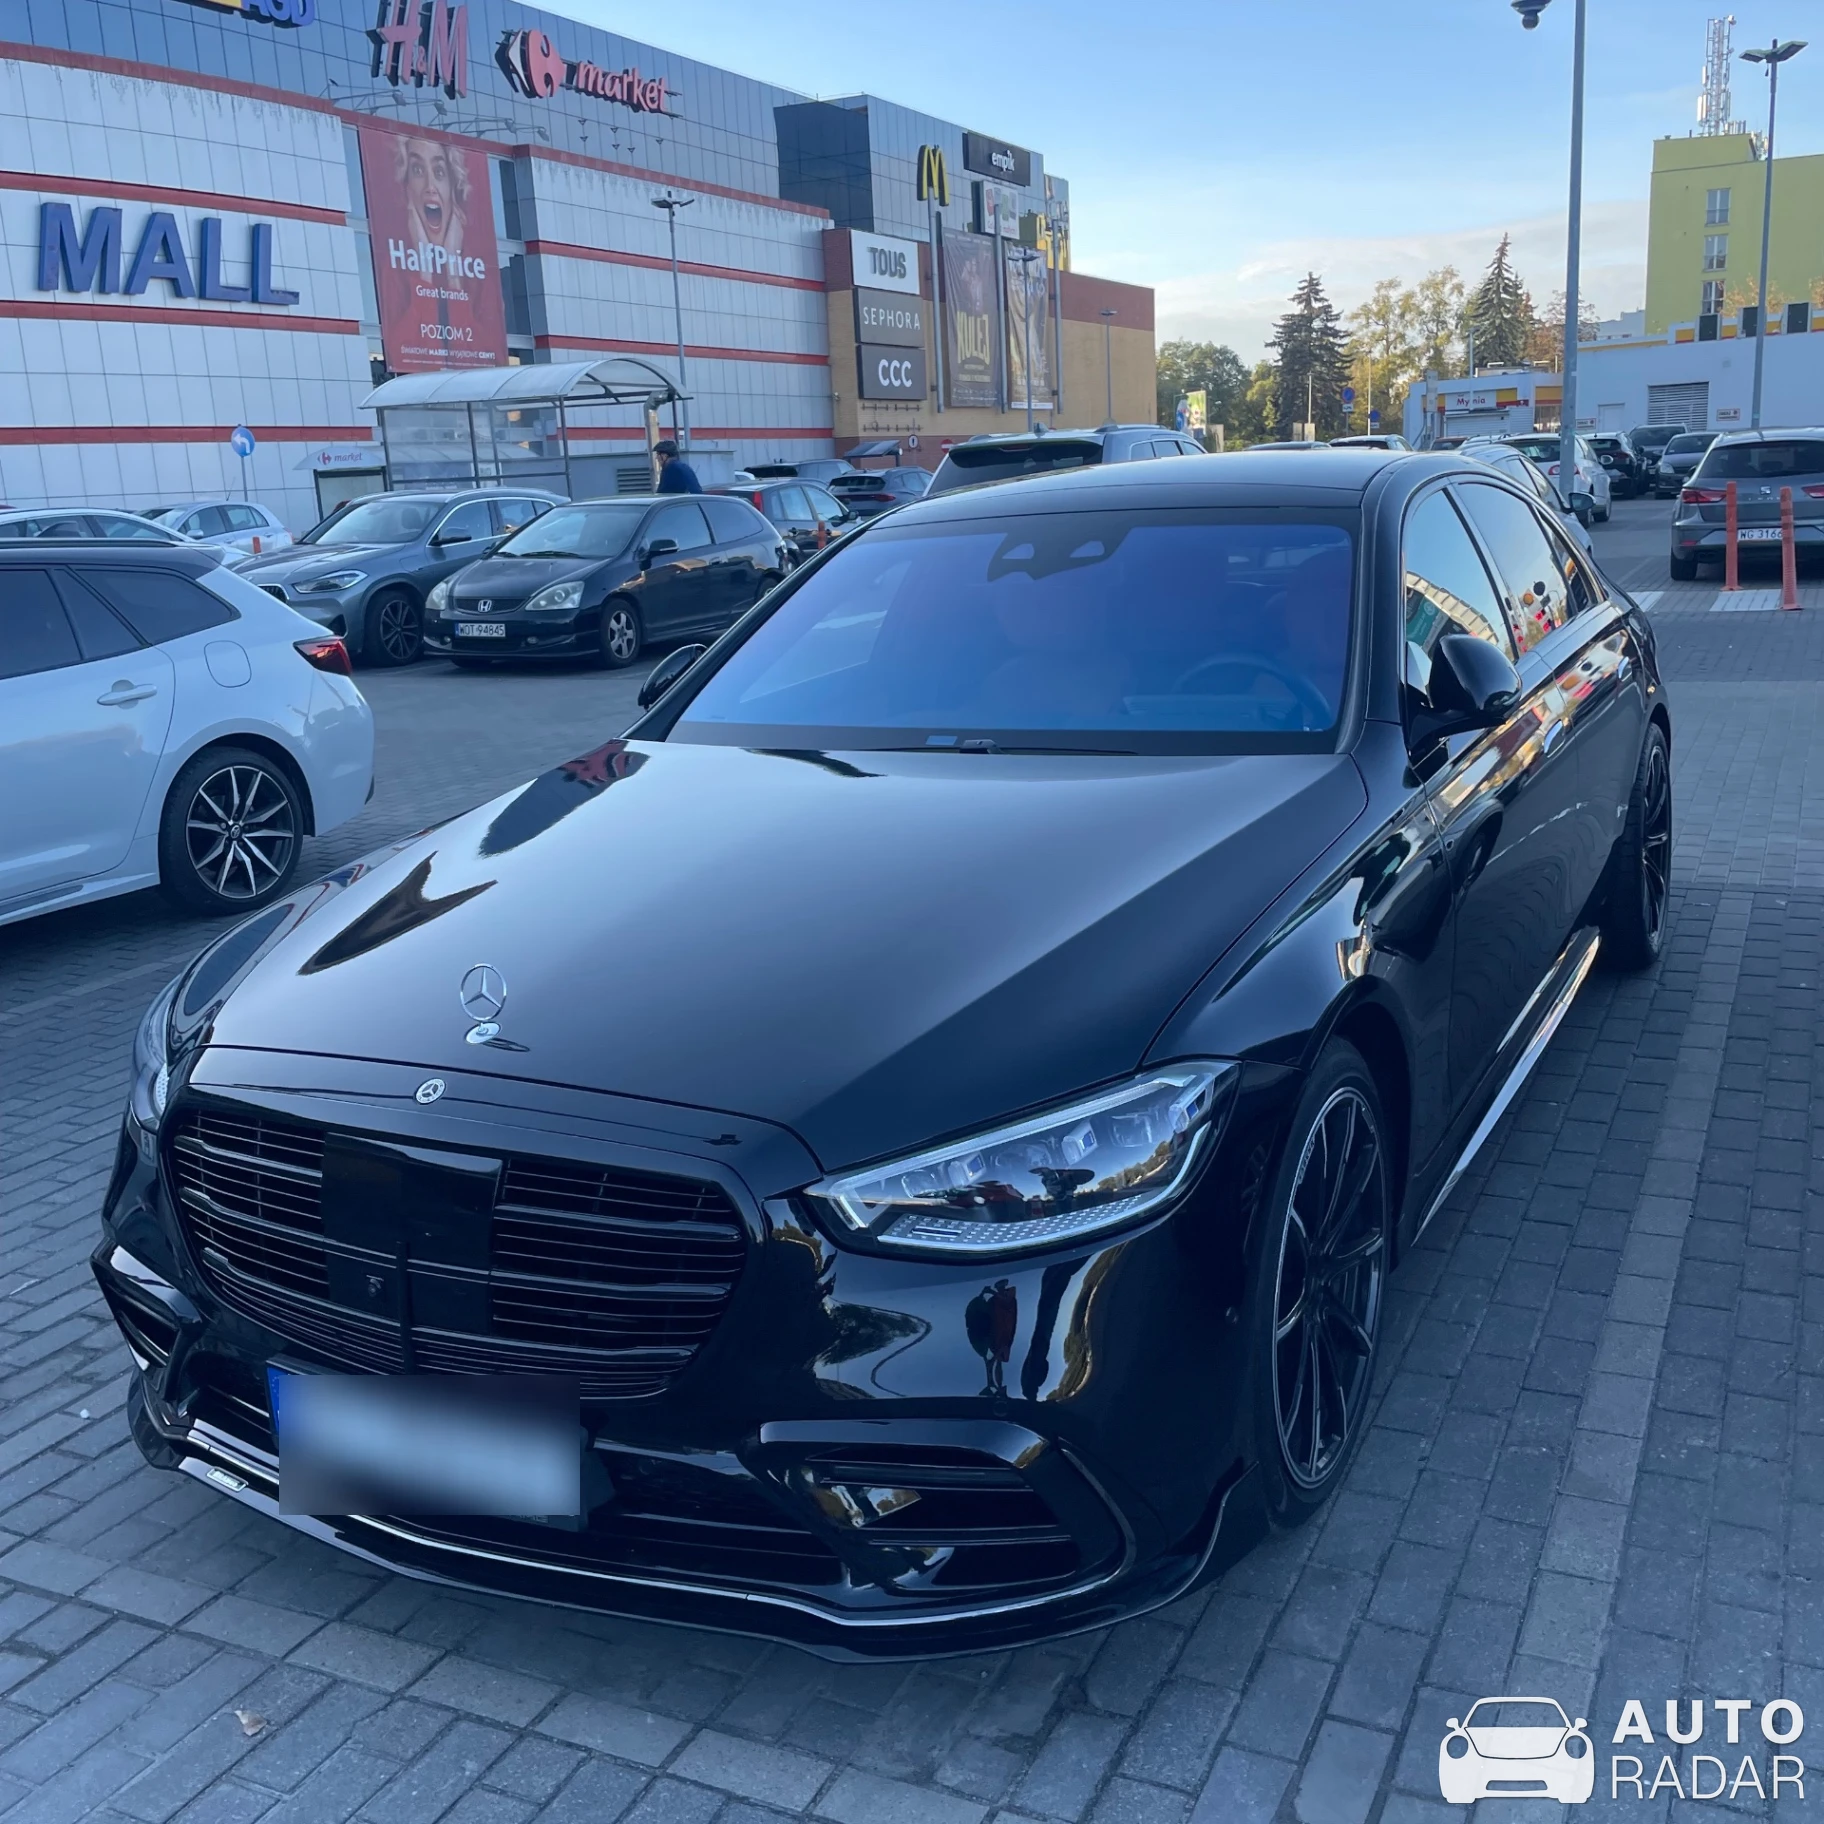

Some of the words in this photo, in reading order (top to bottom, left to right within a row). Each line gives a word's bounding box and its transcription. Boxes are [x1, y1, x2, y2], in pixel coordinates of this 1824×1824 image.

[376, 0, 467, 98] H&M
[577, 60, 668, 112] market
[991, 149, 1015, 172] empik
[38, 202, 299, 305] MALL
[388, 238, 485, 279] HalfPrice
[868, 246, 907, 279] TOUS
[416, 285, 439, 298] Great
[440, 287, 469, 301] brands
[863, 306, 921, 331] SEPHORA
[420, 323, 464, 340] POZIOM
[466, 327, 473, 342] 2
[878, 358, 913, 388] CCC
[1456, 395, 1486, 407] Mynia
[334, 451, 362, 462] market
[1740, 530, 1754, 539] WG
